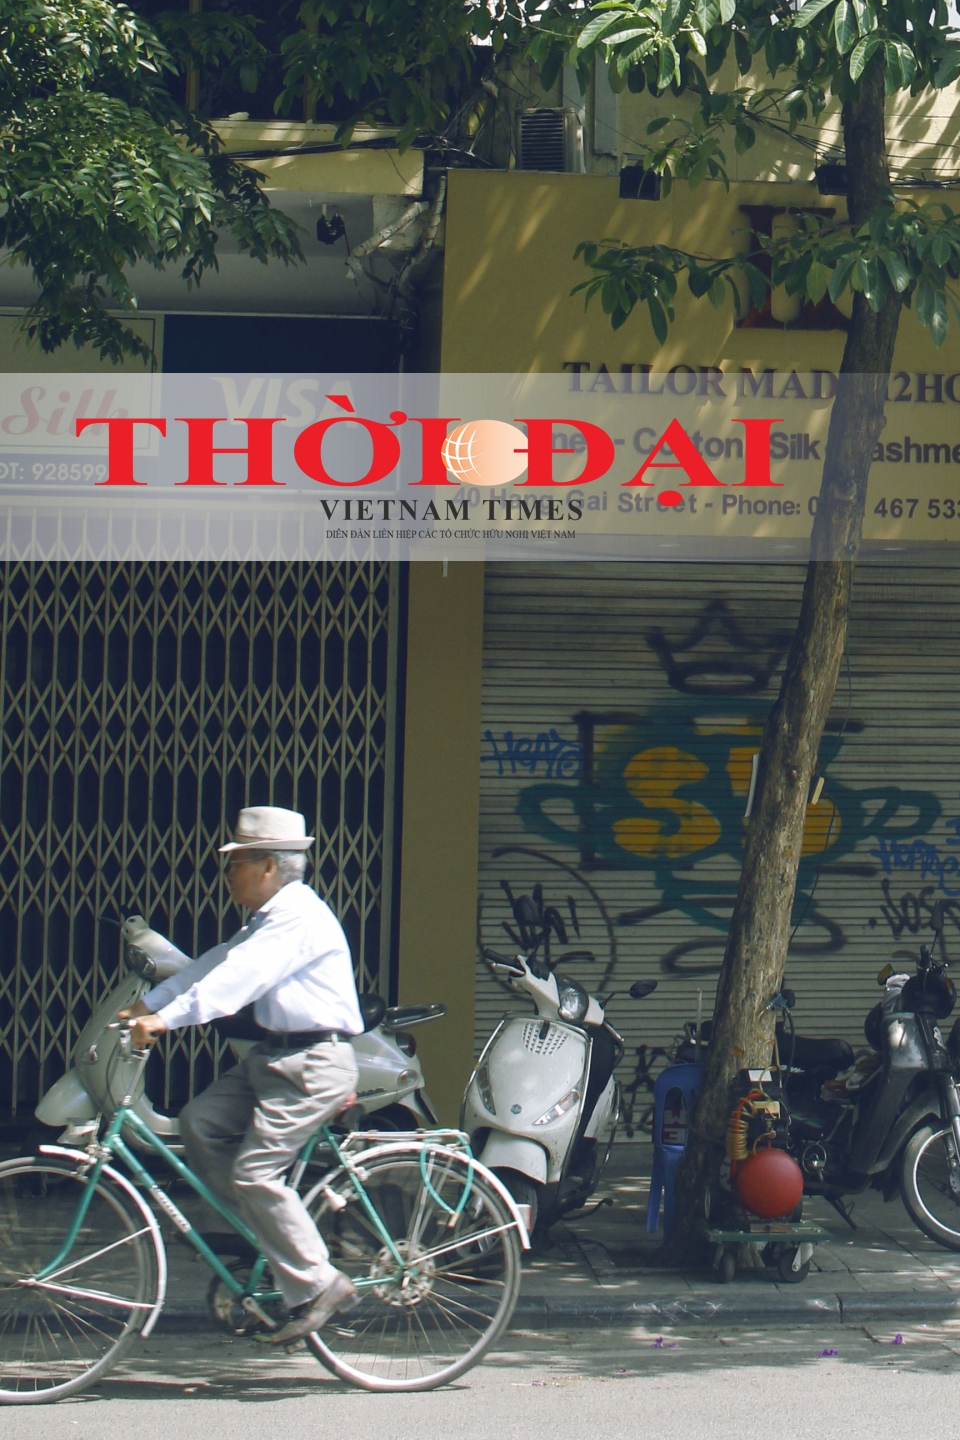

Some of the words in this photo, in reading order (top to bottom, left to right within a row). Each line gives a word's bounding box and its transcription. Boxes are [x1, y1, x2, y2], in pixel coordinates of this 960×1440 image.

[564, 362, 726, 398] TAILOR
[740, 367, 839, 400] MAD
[1, 386, 129, 436] Silk
[209, 377, 359, 428] VISA
[633, 427, 744, 459] Cton
[769, 431, 821, 460] Silk
[722, 494, 801, 515] Phone:
[873, 498, 919, 519] 467
